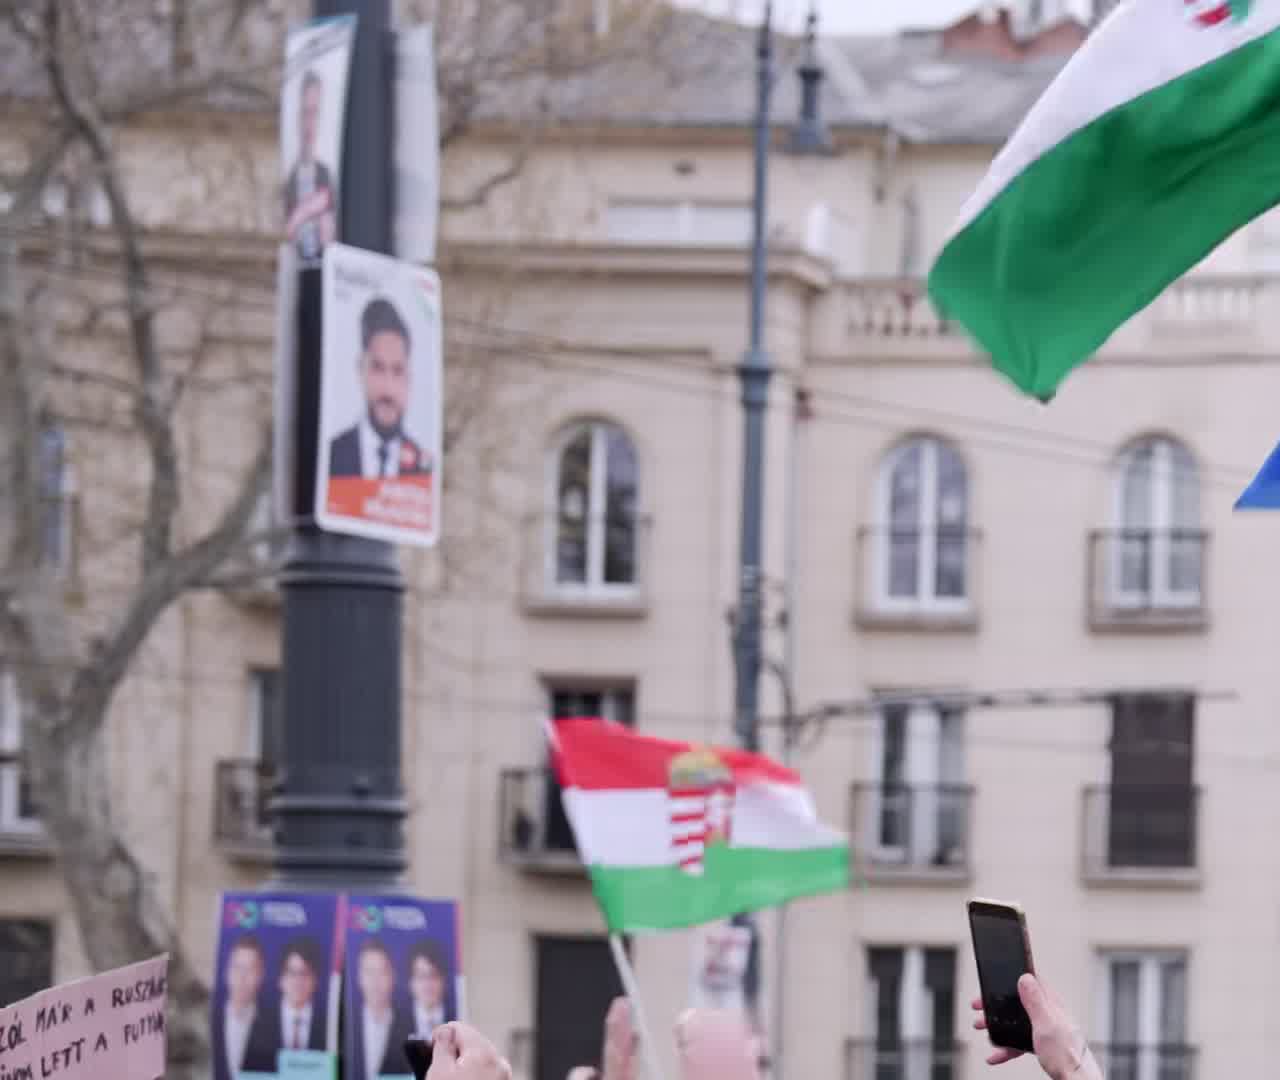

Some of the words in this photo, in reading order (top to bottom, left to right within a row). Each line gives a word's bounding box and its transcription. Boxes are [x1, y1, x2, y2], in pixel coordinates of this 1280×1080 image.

[35, 1000, 72, 1032] MÁR
[84, 997, 95, 1016] A
[41, 1038, 85, 1078] LETT
[95, 1032, 108, 1051] A
